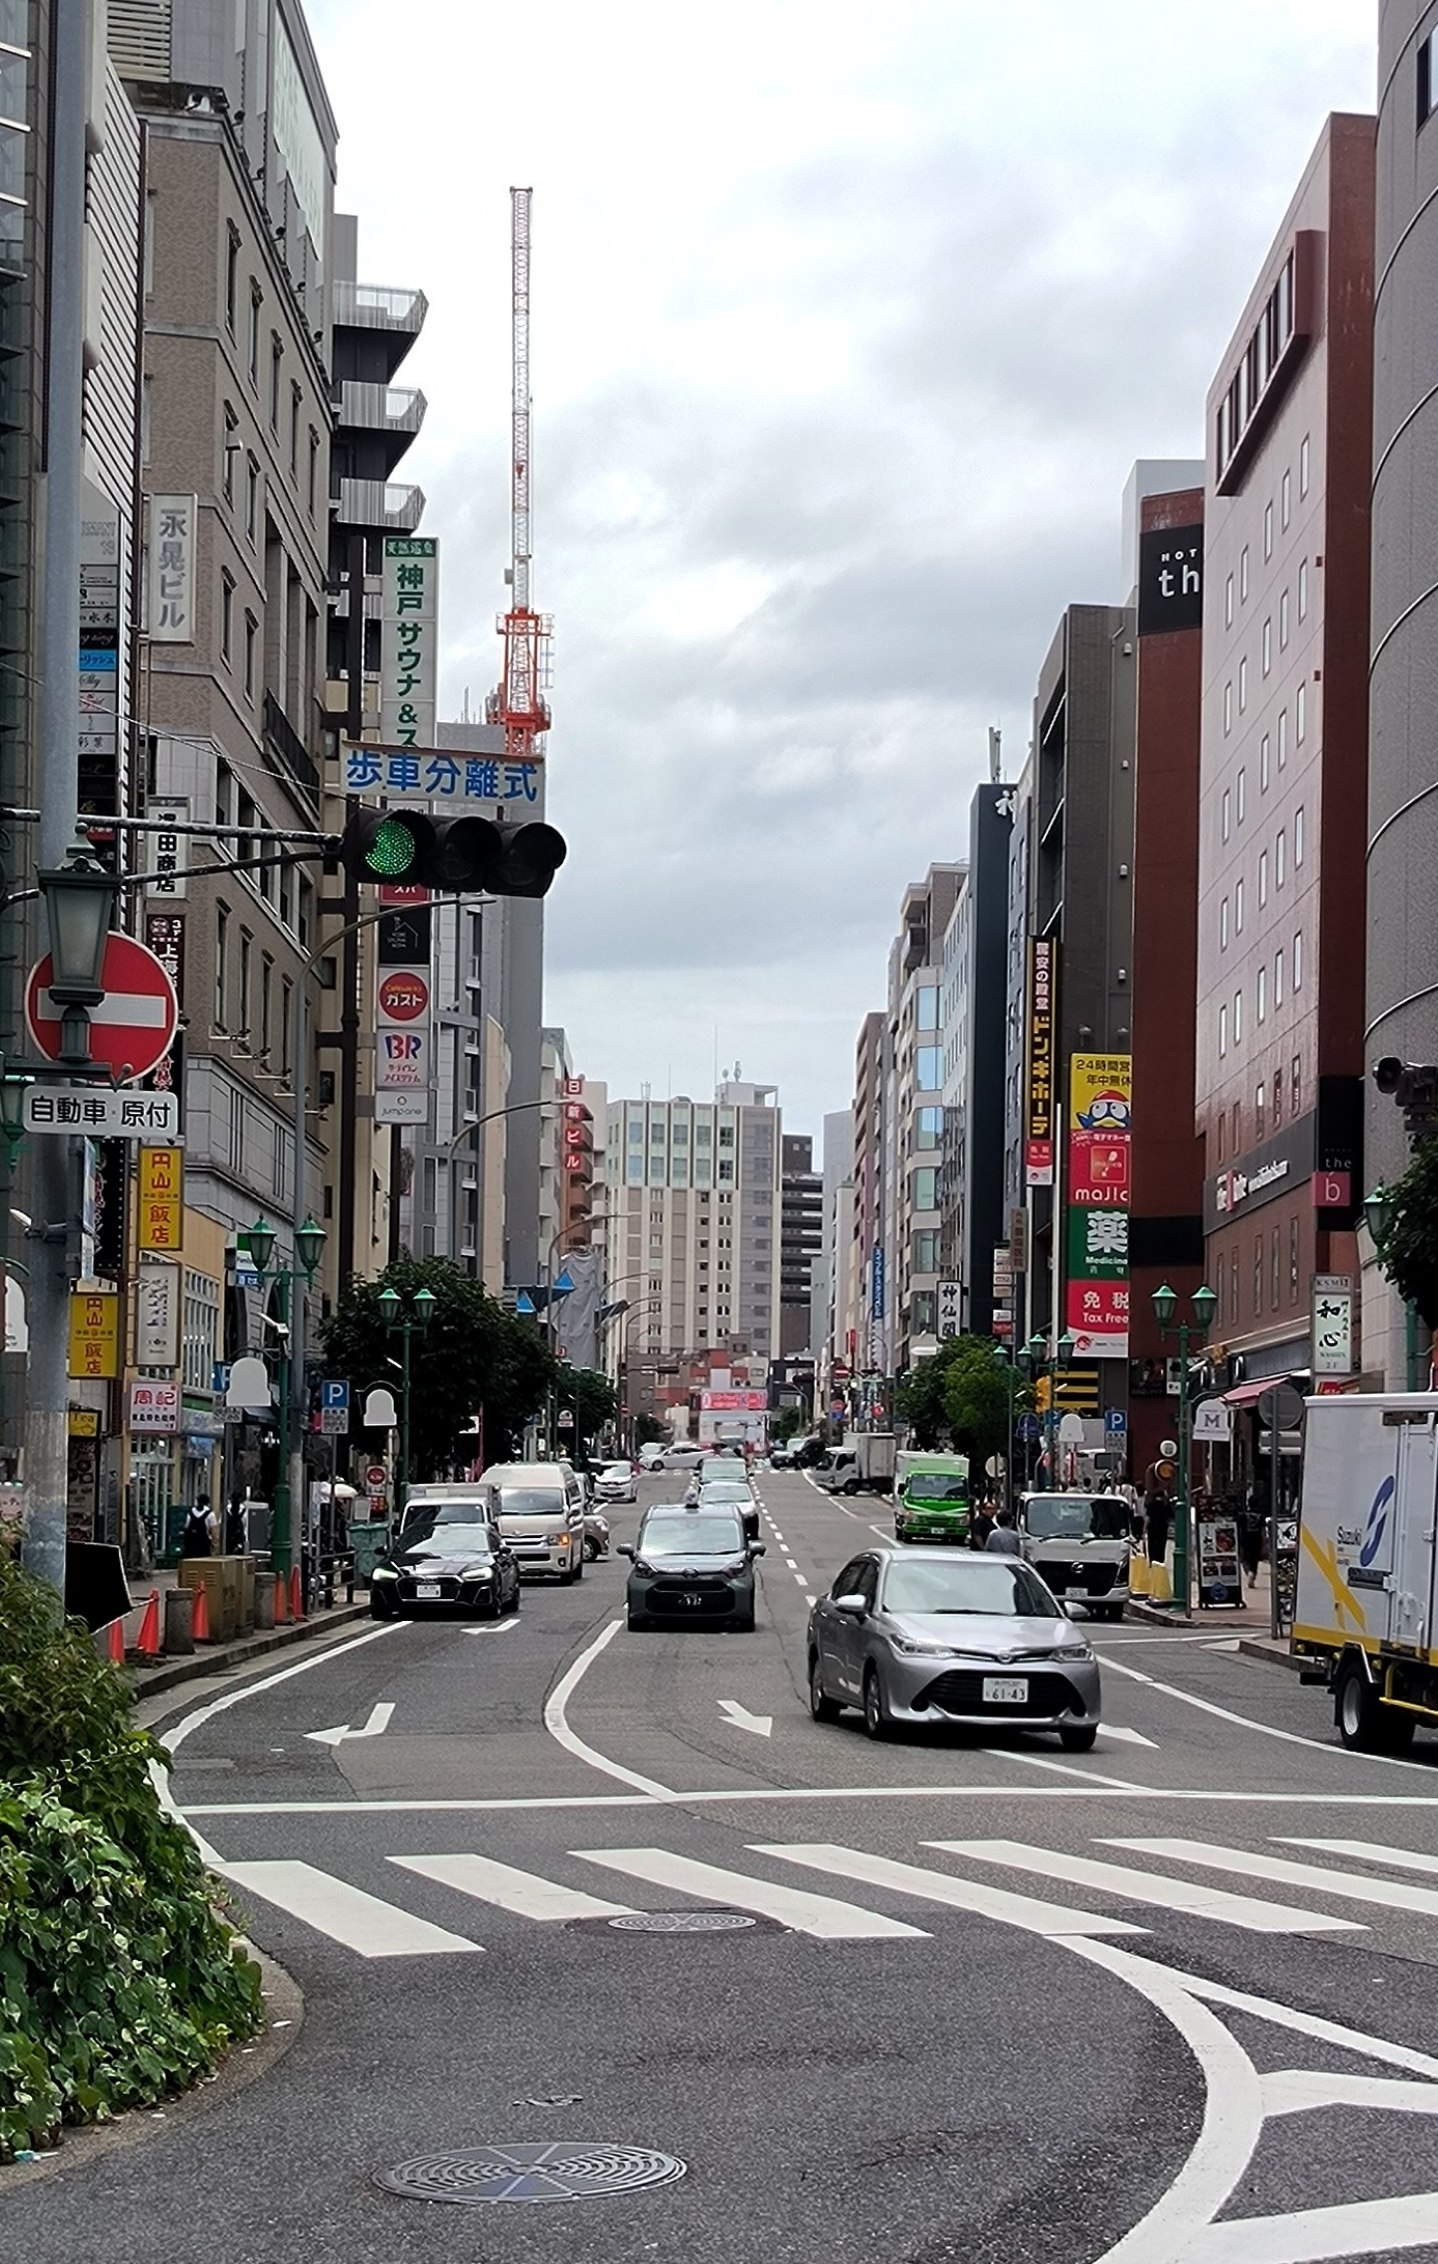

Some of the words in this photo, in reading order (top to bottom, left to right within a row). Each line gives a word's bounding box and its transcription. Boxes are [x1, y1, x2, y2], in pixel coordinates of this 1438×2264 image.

[159, 508, 187, 629] 永晃ビル
[347, 750, 538, 801] 歩車分離式
[387, 993, 422, 1007] ガスト
[384, 1034, 422, 1059] BR
[1032, 1016, 1050, 1134] ドン・キホーテ
[150, 1152, 171, 1243] 円山飯店
[1087, 1211, 1128, 1253] 薬
[1083, 1312, 1103, 1323] Tax
[85, 1298, 103, 1374] 円山飯店
[329, 1384, 343, 1403] P
[1111, 1413, 1123, 1429] P
[1204, 1414, 1220, 1428] M
